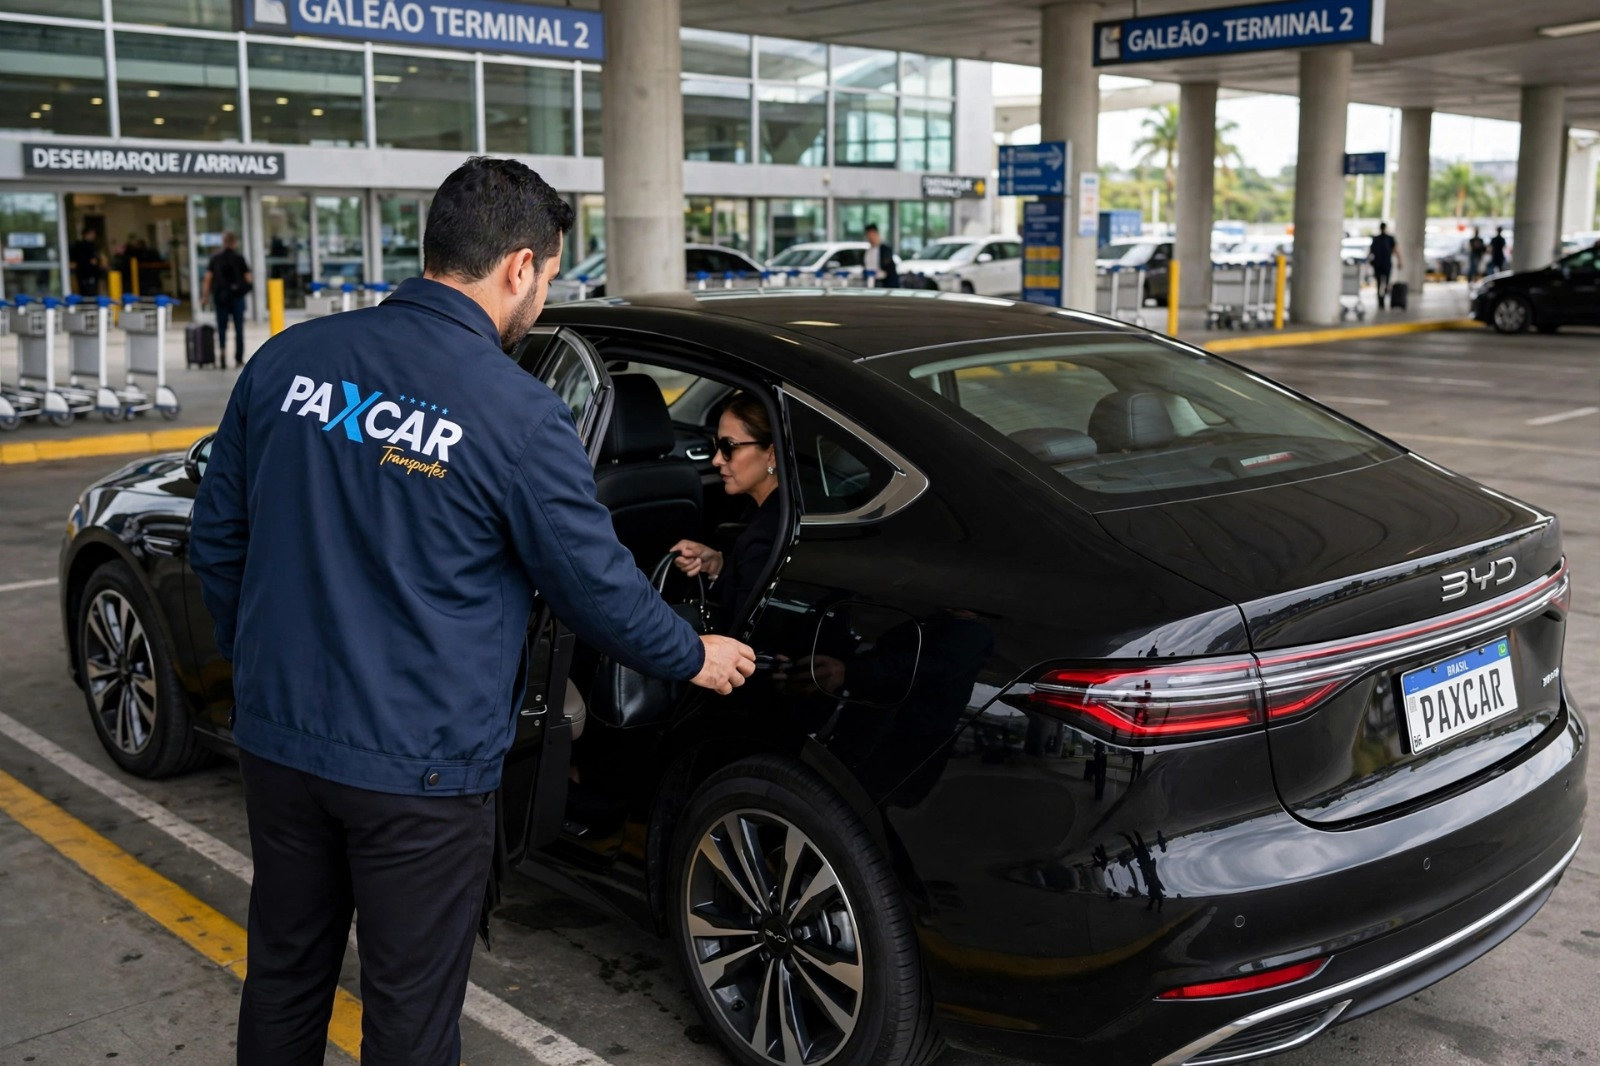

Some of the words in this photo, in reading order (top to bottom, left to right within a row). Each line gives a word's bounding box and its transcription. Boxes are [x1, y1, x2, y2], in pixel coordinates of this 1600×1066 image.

[430, 6, 568, 47] TERMINAL
[573, 22, 589, 49] 2
[1127, 21, 1209, 52] GALEÃO
[1223, 10, 1333, 43] TERMINAL
[1339, 7, 1354, 31] 2
[32, 148, 180, 173] DESEMBARQUE
[194, 153, 279, 174] ARRIVALS
[280, 374, 463, 463] PAXCAR
[379, 445, 448, 479] Transportes
[1440, 556, 1517, 602] BYD
[1446, 660, 1470, 677] BRASIL
[1420, 668, 1505, 739] PAXCAR
